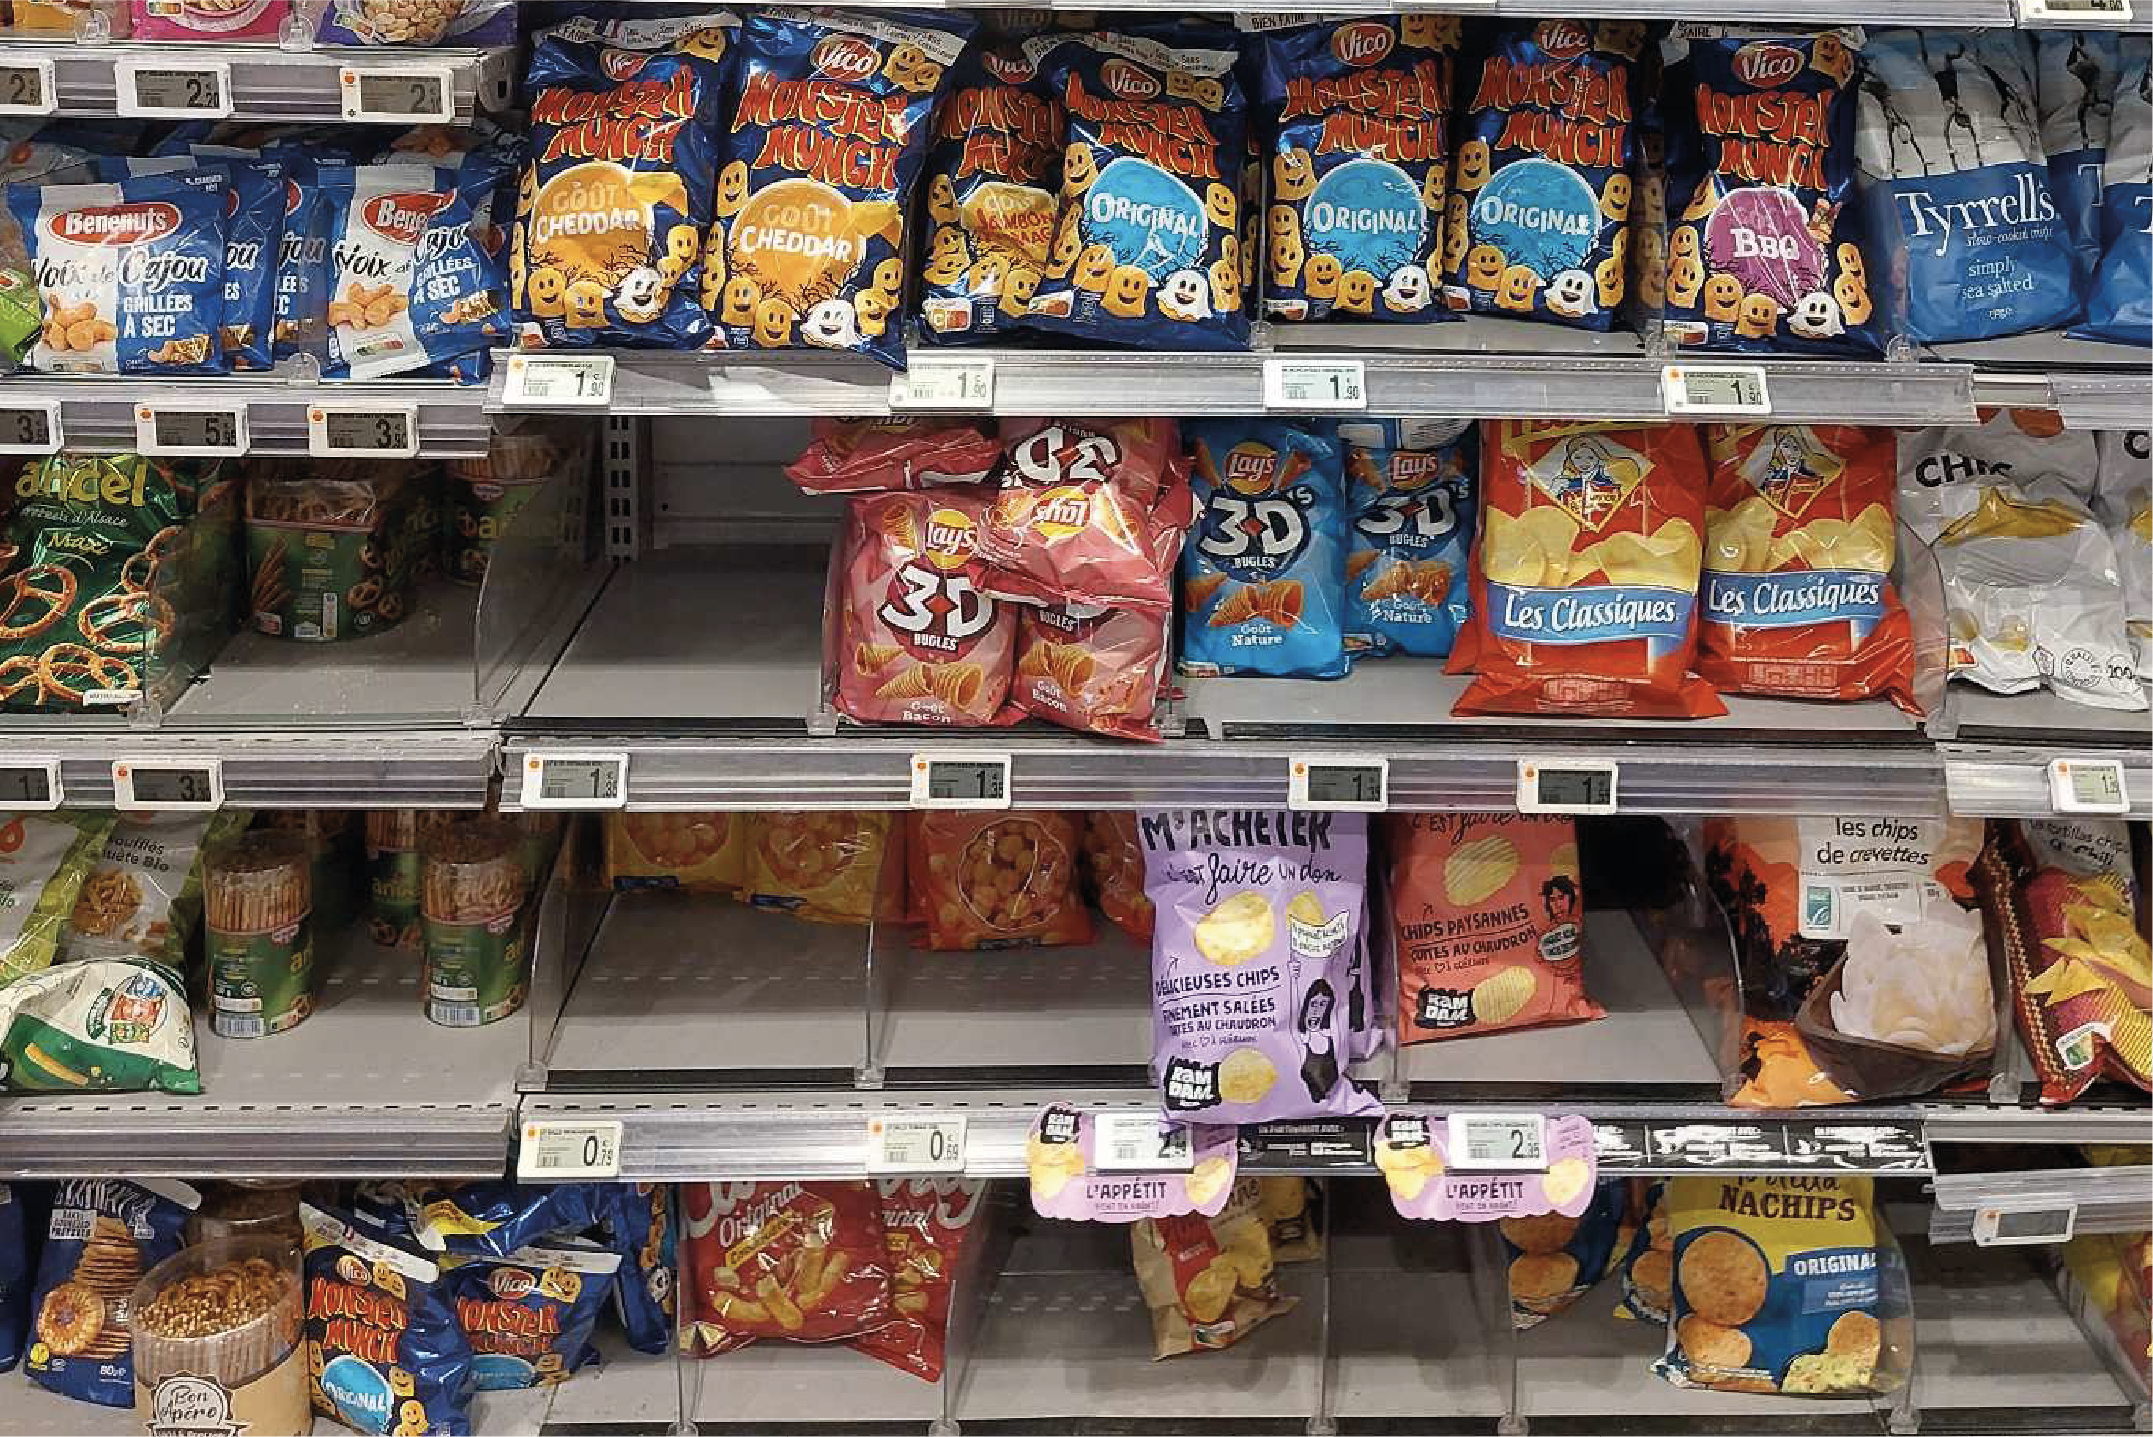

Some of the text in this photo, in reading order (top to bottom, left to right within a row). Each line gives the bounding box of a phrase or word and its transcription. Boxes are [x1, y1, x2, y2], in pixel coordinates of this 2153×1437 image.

[1339, 29, 1387, 61] Vico
[1110, 67, 1155, 95] Vico
[1740, 54, 1796, 81] Vico
[186, 78, 202, 107] 2
[1278, 58, 1448, 122] MONSTER
[1469, 54, 1632, 123] MONSTER
[731, 71, 909, 145] MONSTER
[1315, 110, 1441, 162] MUNCH
[1494, 110, 1626, 168] MUNCH
[750, 124, 899, 192] MUNCH
[65, 208, 167, 236] Benenuts
[537, 209, 642, 242] CHEDDAR
[1090, 191, 1198, 238] ORIGINAL
[1312, 202, 1418, 236] ORIGINAL
[1480, 195, 1591, 236] ORIGINAL
[739, 225, 852, 263] CHEDDAR
[119, 245, 209, 294] Cajou
[335, 243, 391, 279] Noix
[1968, 255, 2016, 277] simply
[427, 274, 462, 301] SEC
[1986, 274, 2033, 298] salted
[141, 315, 177, 338] SEC
[17, 415, 34, 444] 3
[204, 417, 221, 444] 5
[375, 418, 391, 449] 3
[1232, 555, 1276, 570] BUGLES
[1505, 591, 1678, 634] Les Classiques
[1709, 574, 1880, 623] Les Classiques
[1383, 608, 1434, 624] Nature
[914, 633, 959, 652] BUGLES
[1231, 633, 1284, 648] Nature
[902, 709, 952, 725] Bacon
[1836, 817, 1918, 844] les chips
[1817, 842, 1929, 866] de crevettes
[1204, 853, 1274, 906] faire
[1300, 852, 1342, 885] don
[1401, 903, 1530, 941] CHIPS PAYSANNES
[1453, 942, 1472, 955] AU
[1472, 924, 1539, 954] CHAUDRON
[1236, 965, 1281, 989] CHIPS
[1223, 997, 1276, 1015] SALÉES
[1197, 1020, 1212, 1033] AU
[1215, 1014, 1277, 1031] CHAUDRON
[583, 1135, 598, 1167] 0
[930, 1129, 944, 1161] 0
[1510, 1128, 1526, 1160] 2
[1086, 1177, 1168, 1200] L'APPÉTIT
[1446, 1177, 1524, 1200] L'APPÉTIT
[1718, 1186, 1857, 1222] NACHIPS
[718, 1180, 806, 1248] Original
[170, 1384, 208, 1405] Bon
